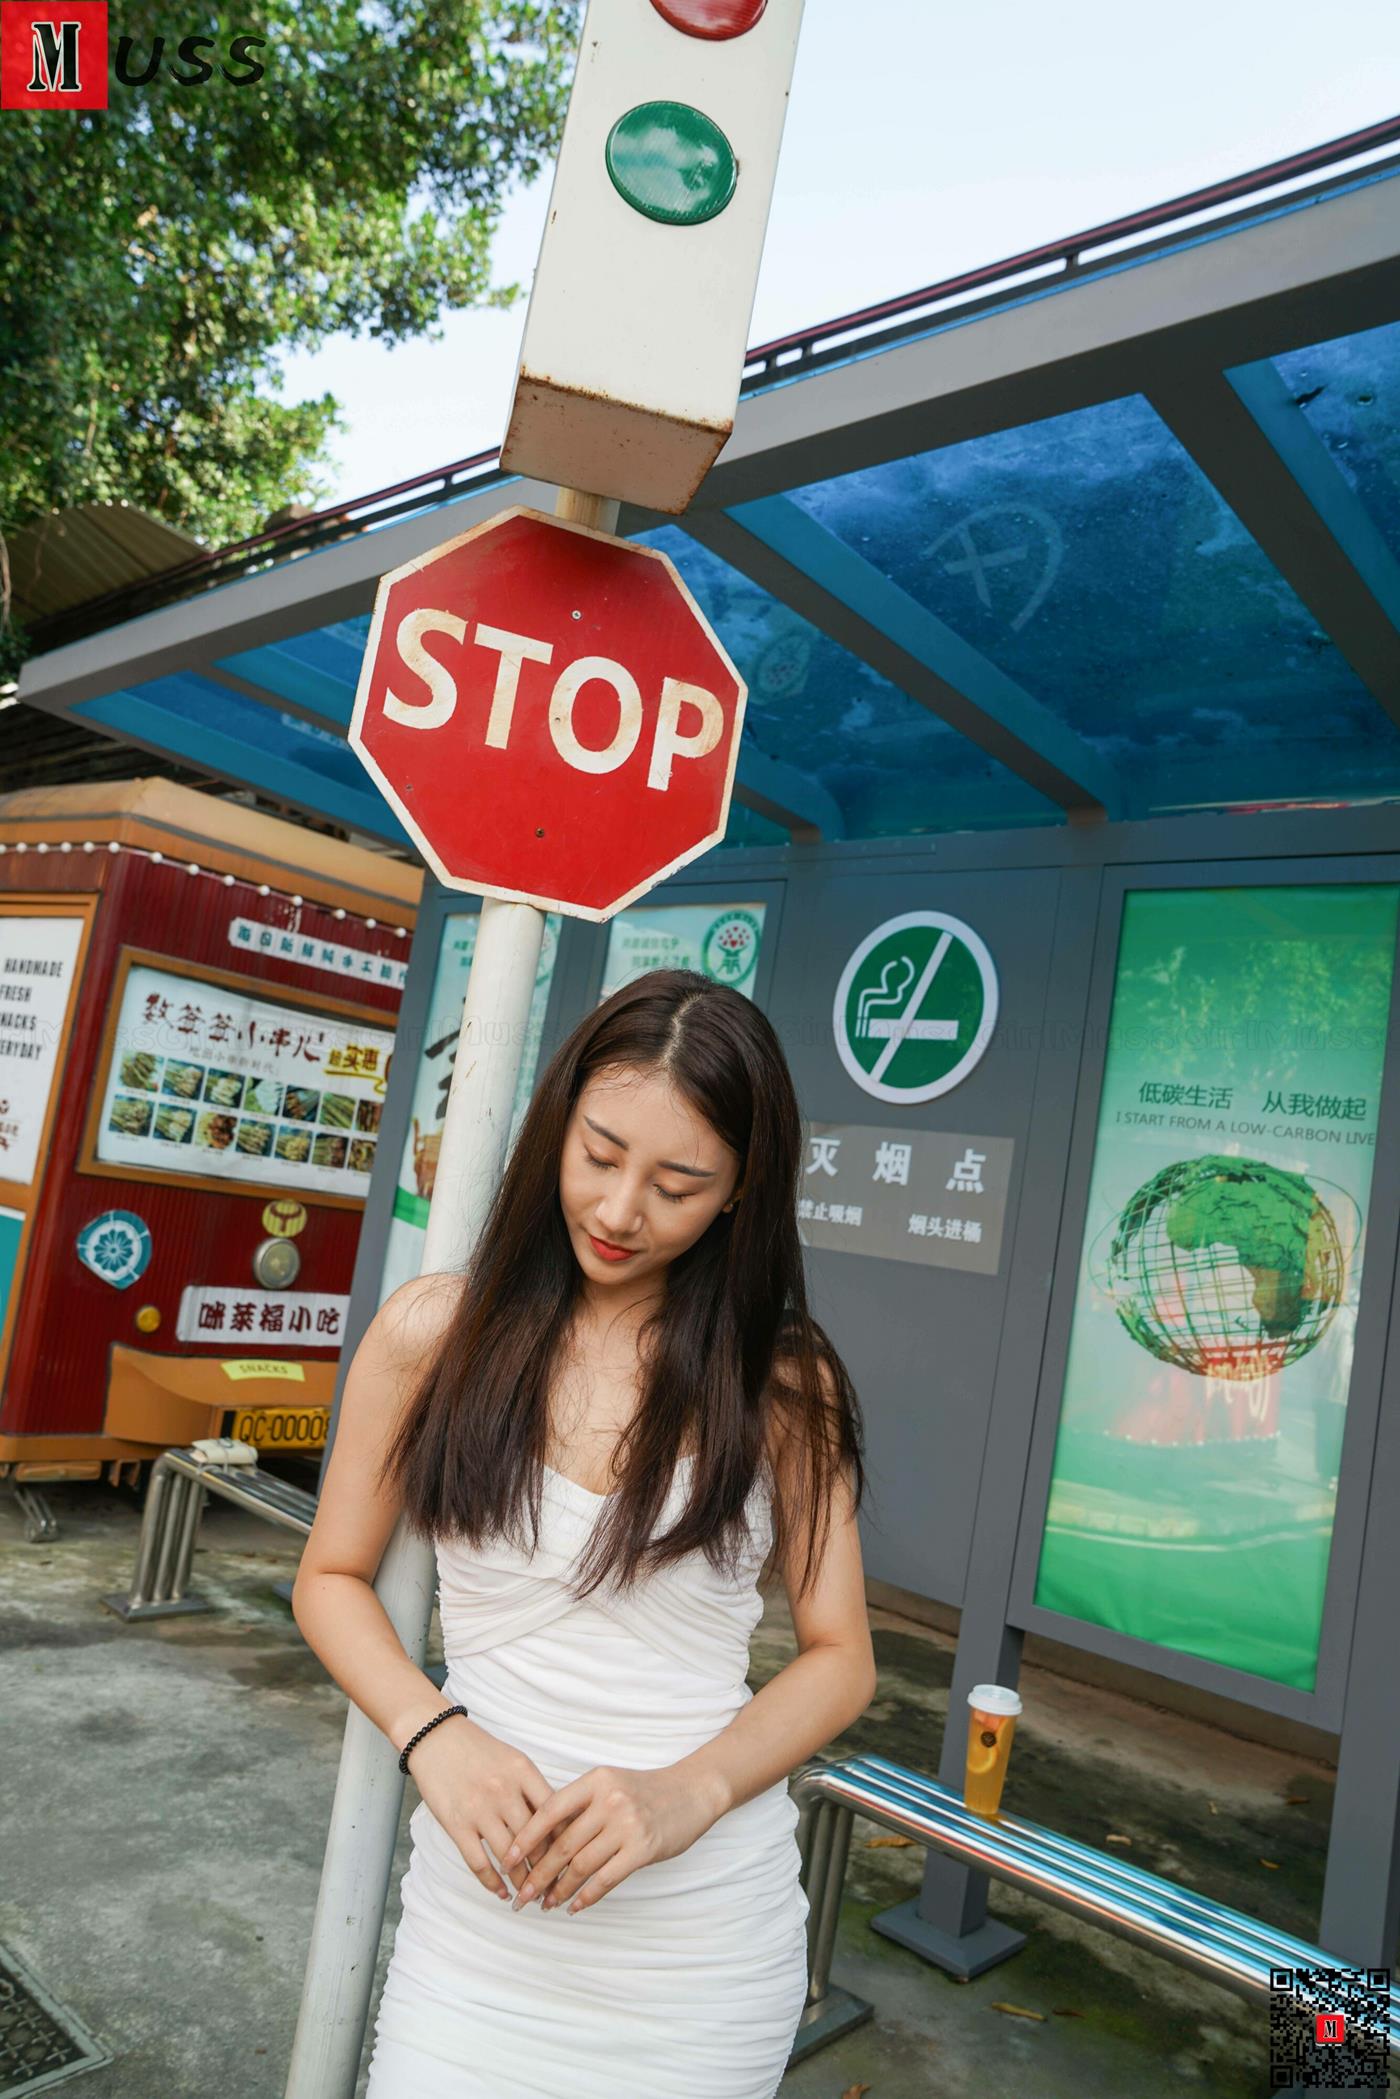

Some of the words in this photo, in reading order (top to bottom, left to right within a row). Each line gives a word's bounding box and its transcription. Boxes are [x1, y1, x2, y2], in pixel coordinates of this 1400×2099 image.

[382, 608, 724, 791] STOP
[4, 958, 63, 978] HANDMADE
[0, 1011, 37, 1031] NACKS
[1139, 1081, 1233, 1110] 低碳生活
[1262, 1090, 1366, 1121] 从我做起
[1124, 1111, 1165, 1126] START
[1169, 1115, 1211, 1131] FROM
[1215, 1120, 1226, 1132] A
[1230, 1121, 1341, 1144] LOW-CARBON
[798, 1199, 862, 1227] 禁止吸烟
[907, 1213, 982, 1244] 烟头进桶
[239, 1415, 329, 1442] QC-0000
